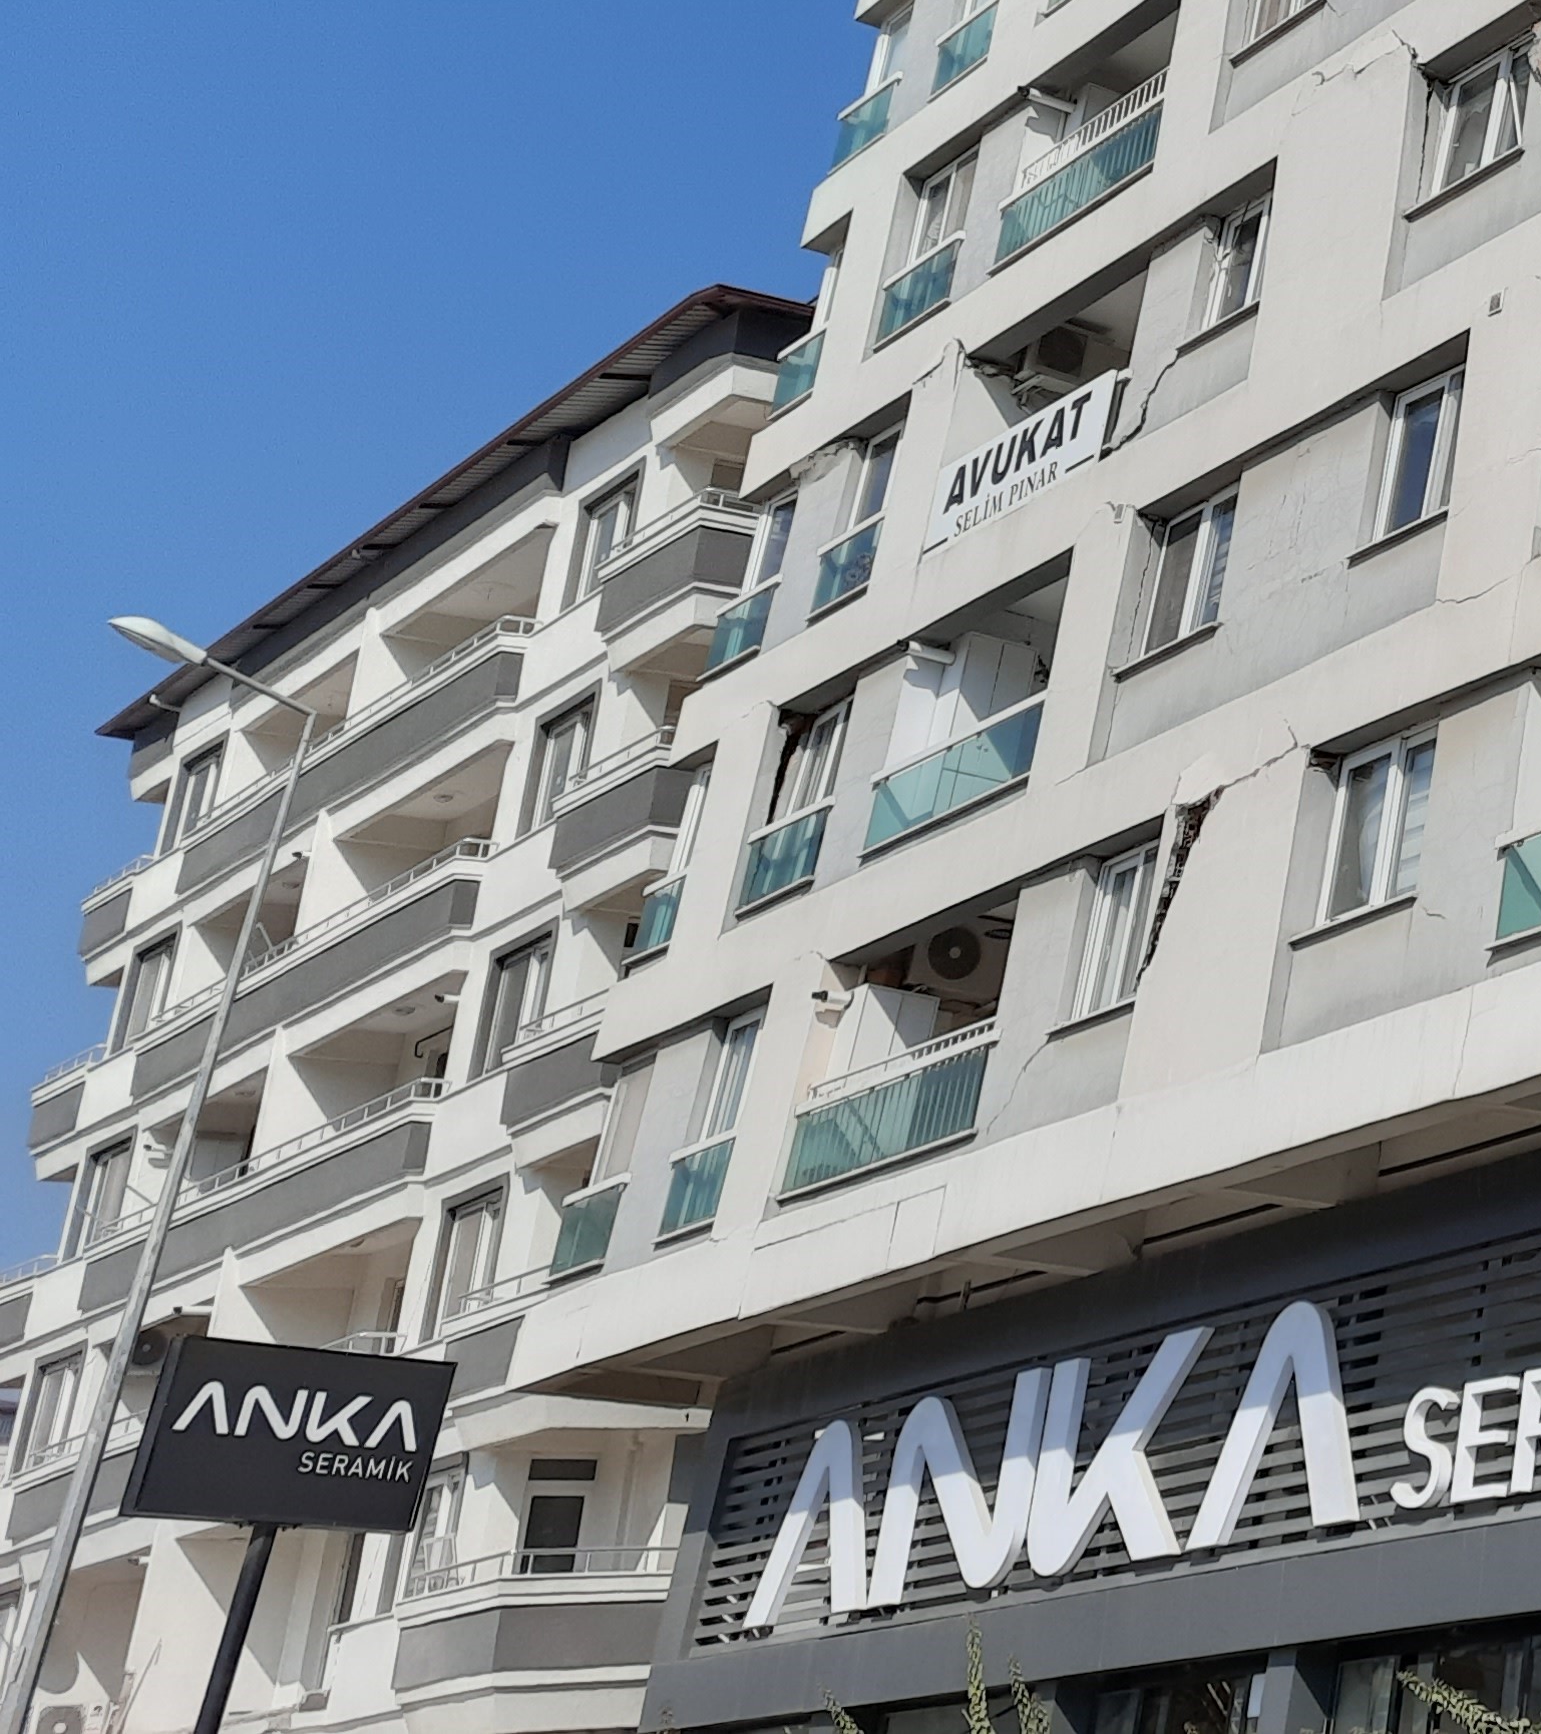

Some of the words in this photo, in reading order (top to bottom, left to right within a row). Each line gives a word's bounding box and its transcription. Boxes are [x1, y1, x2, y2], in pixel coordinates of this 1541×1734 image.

[943, 391, 1092, 514] AVUKAT
[953, 493, 1004, 537] SELİM
[1008, 461, 1058, 506] PINAR
[172, 1381, 417, 1452] ANKA
[297, 1452, 413, 1483] SERAMİK
[743, 1300, 1360, 1628] ANKA
